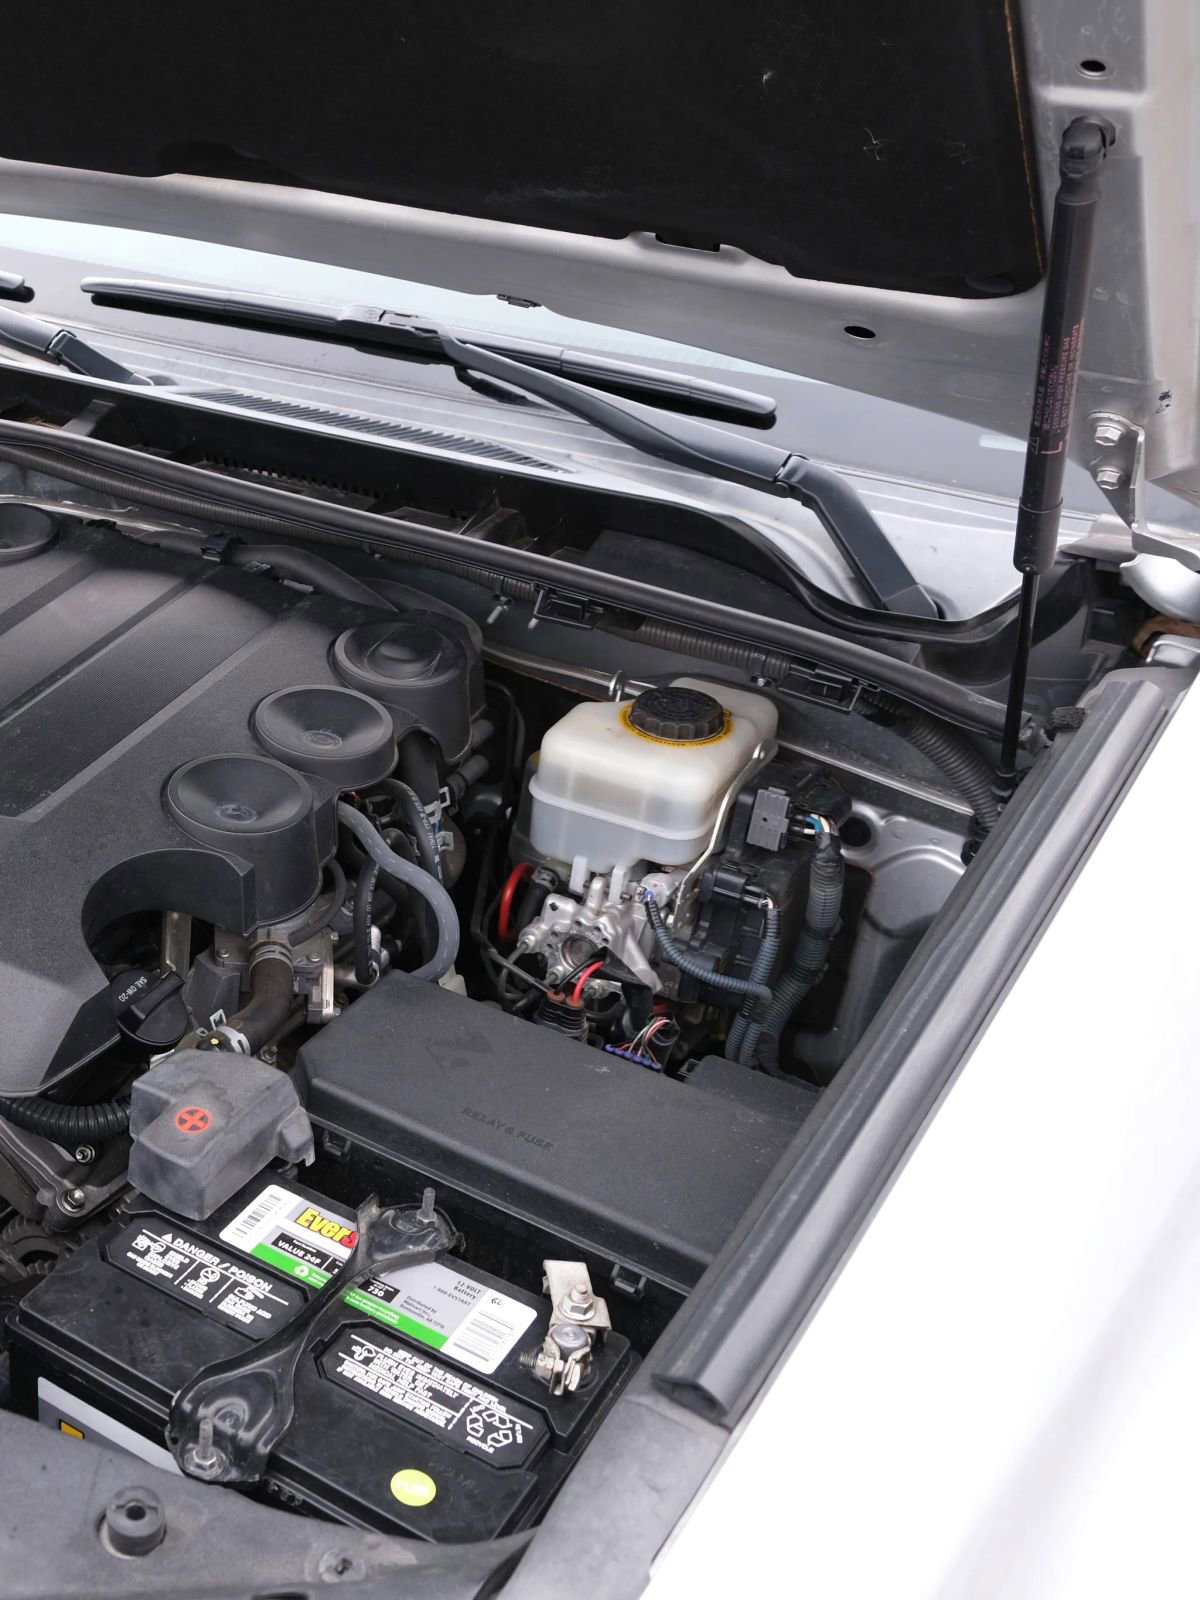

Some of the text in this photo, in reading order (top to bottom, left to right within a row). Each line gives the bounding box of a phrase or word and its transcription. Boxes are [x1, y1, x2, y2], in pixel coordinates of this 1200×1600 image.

[118, 976, 148, 1002] SAE 0W-20
[462, 1107, 506, 1129] RELAY
[517, 1131, 554, 1152] FUSE
[278, 1240, 305, 1258] VALUE
[304, 1253, 322, 1264] 24F
[173, 1238, 220, 1267] DANGER
[228, 1266, 272, 1291] POISON
[367, 1286, 384, 1298] 730
[454, 1286, 476, 1300] Battery
[457, 1280, 480, 1294] 12-VOLT
